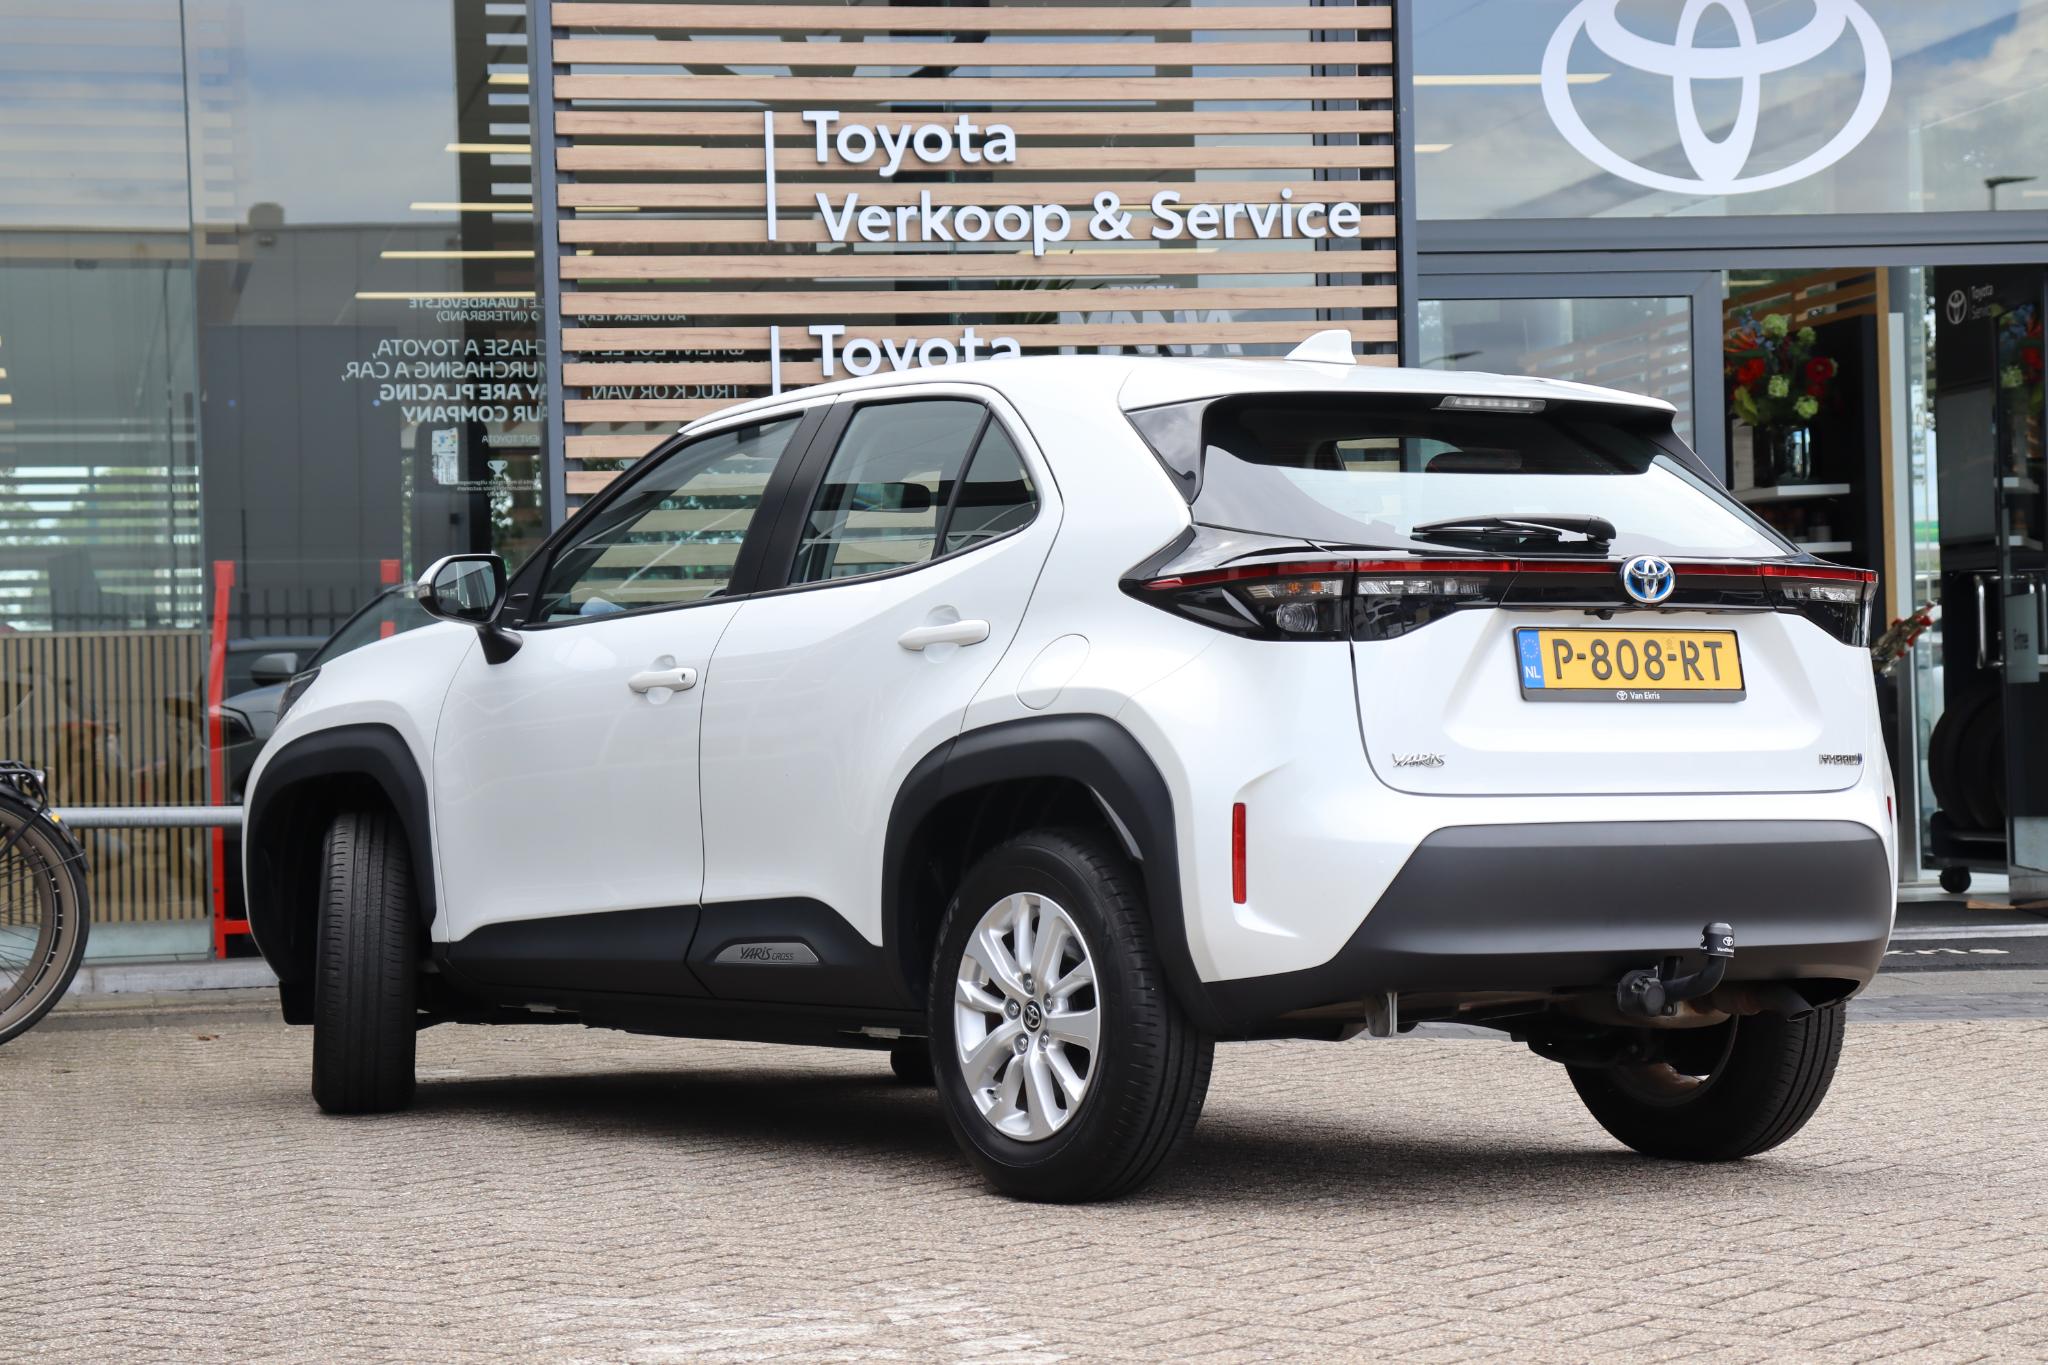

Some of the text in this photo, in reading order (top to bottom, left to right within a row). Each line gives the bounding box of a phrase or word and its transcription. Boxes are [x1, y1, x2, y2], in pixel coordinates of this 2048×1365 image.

[803, 111, 1016, 177] Toyota
[815, 188, 1361, 256] Verkoop & Service
[808, 325, 1021, 376] Toyota
[1525, 665, 1541, 678] NL
[1551, 639, 1723, 681] P-808-RT
[1630, 691, 1660, 700] Van Ekris
